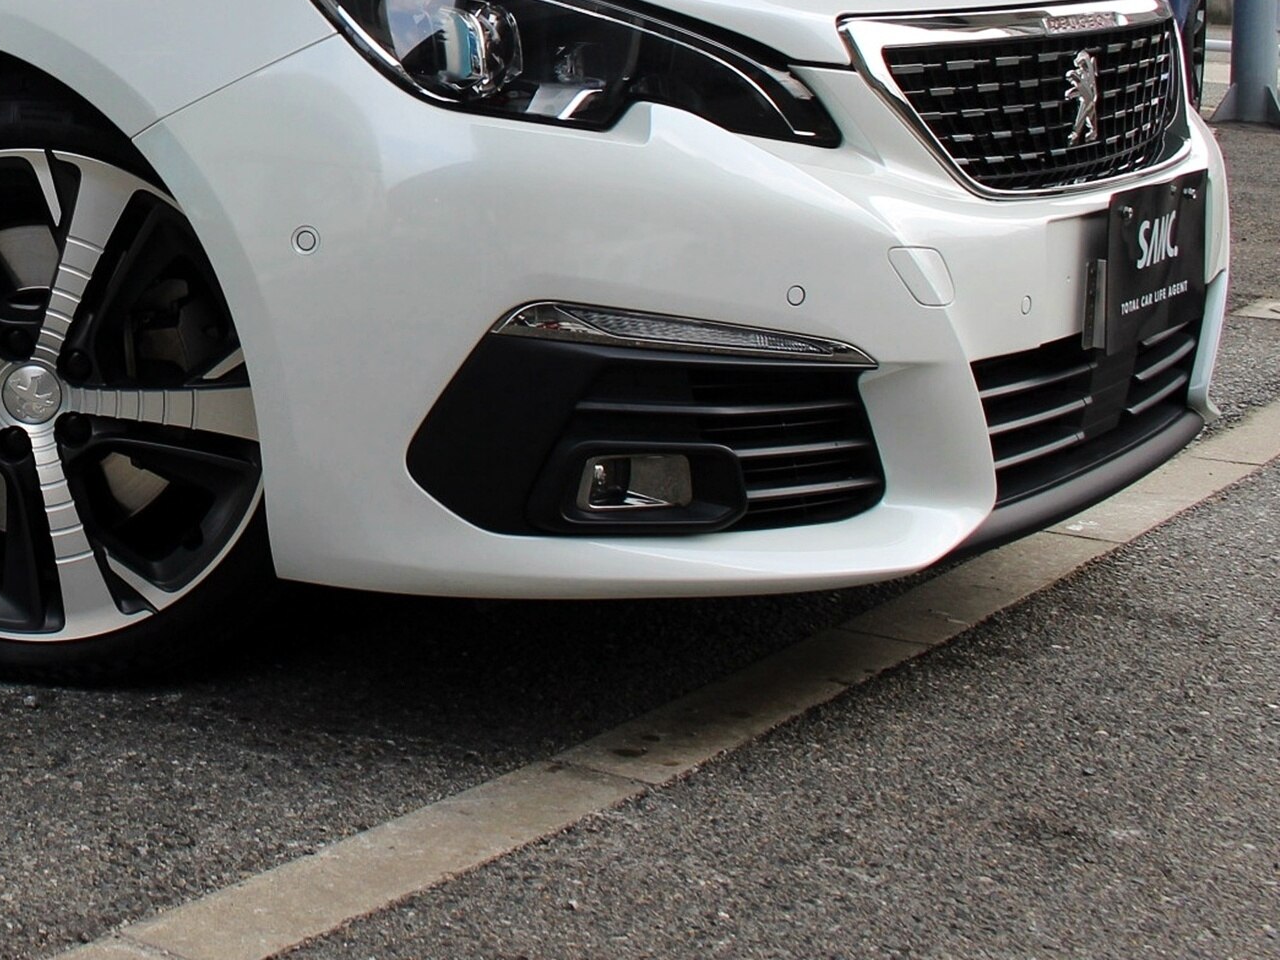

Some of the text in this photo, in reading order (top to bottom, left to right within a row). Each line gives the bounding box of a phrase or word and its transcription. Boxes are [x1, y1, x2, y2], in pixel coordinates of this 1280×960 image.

[1121, 280, 1189, 316] TOTAL CAR LIFE AGENT
